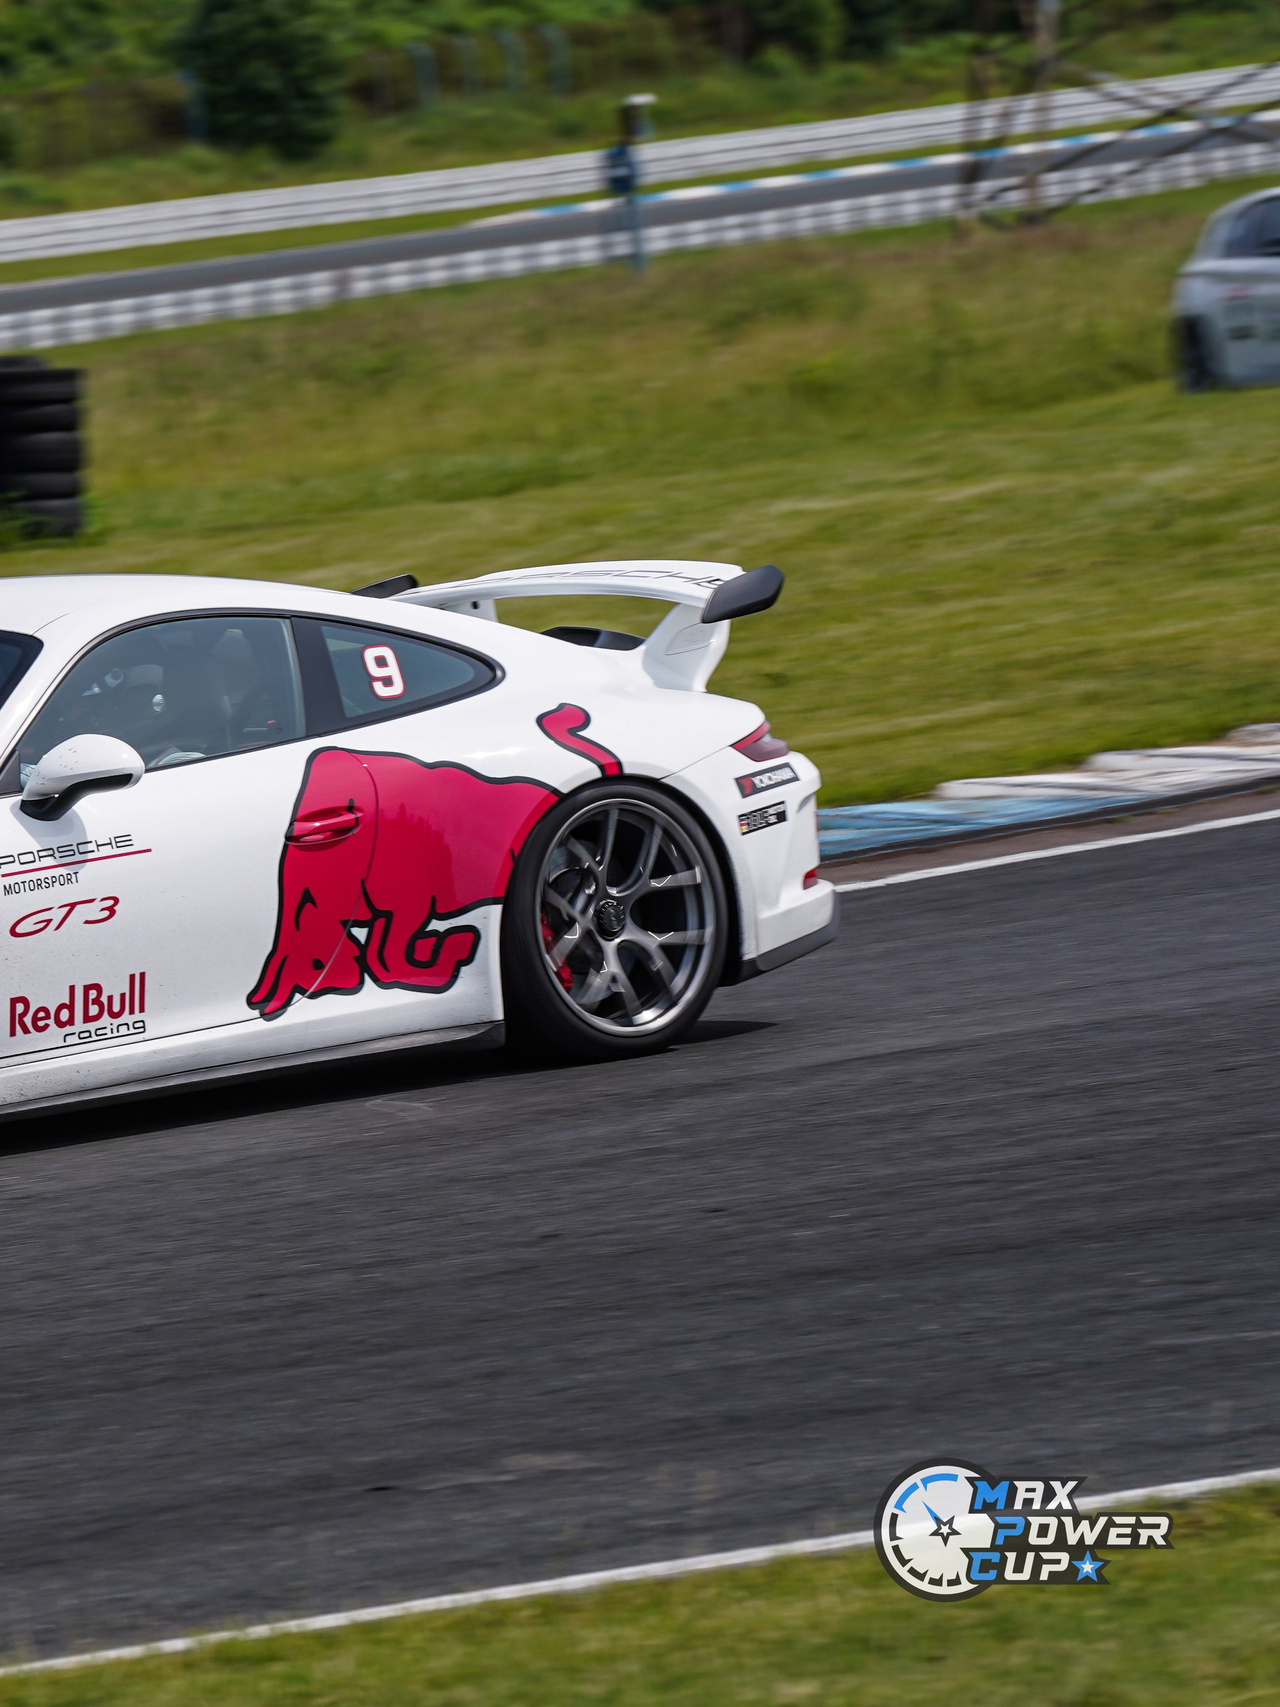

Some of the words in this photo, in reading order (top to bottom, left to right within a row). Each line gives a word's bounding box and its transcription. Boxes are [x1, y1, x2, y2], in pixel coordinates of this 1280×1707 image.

[361, 644, 405, 699] 9
[3, 871, 80, 896] MOTORSPORT
[9, 896, 120, 938] GT3
[9, 985, 76, 1038] Red
[82, 971, 146, 1025] Bull
[63, 1019, 146, 1043] racing
